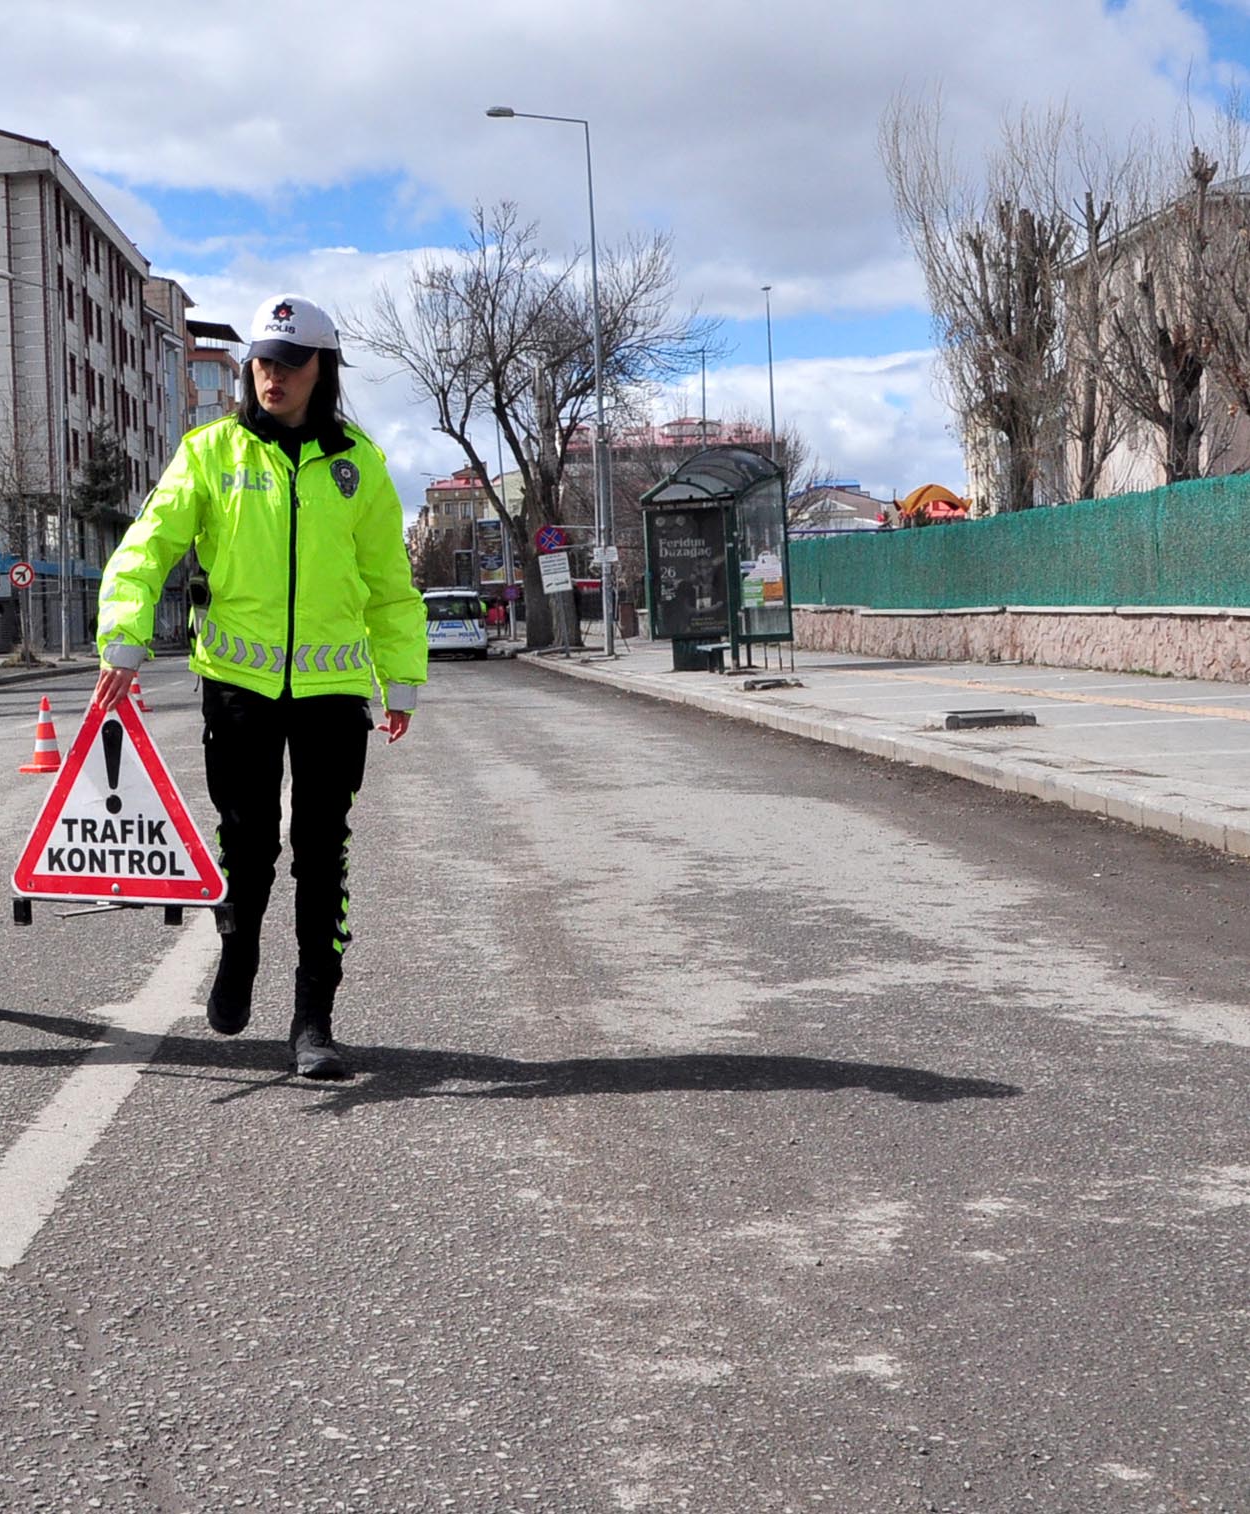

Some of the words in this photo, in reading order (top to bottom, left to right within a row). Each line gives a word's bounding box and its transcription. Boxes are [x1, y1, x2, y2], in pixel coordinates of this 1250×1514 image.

[658, 537, 706, 548] Feridun
[660, 565, 676, 579] 26
[61, 813, 168, 846] TRAFİK
[47, 846, 185, 877] KONTROL
